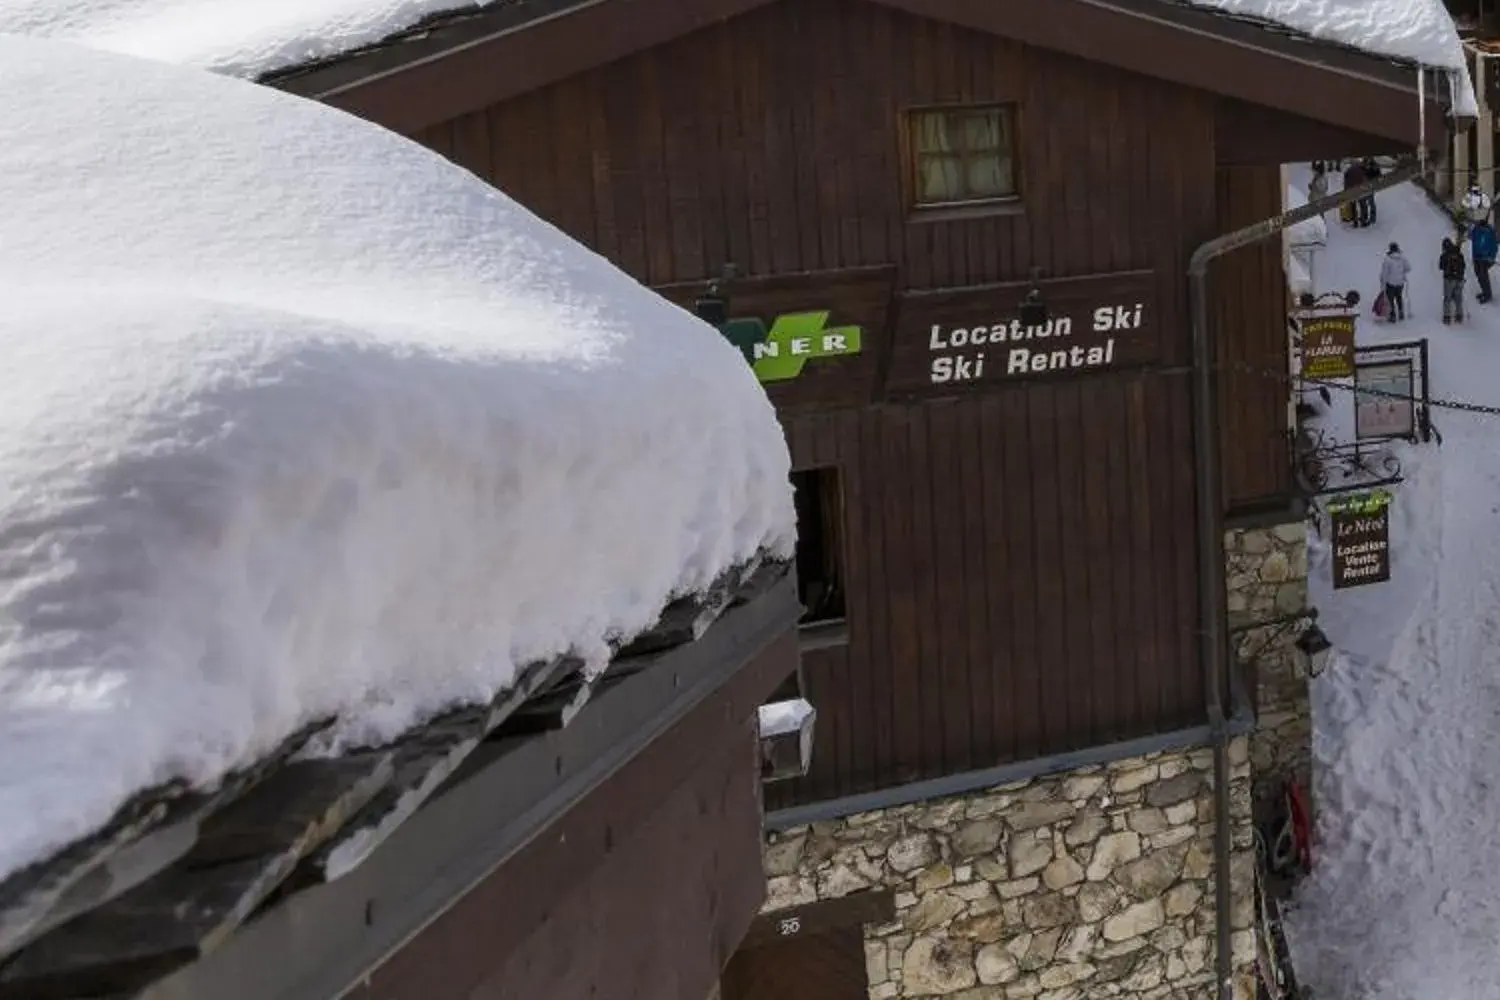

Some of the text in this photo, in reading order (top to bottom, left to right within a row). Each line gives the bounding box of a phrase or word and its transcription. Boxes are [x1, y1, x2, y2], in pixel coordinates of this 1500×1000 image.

[1093, 302, 1143, 331] Ski
[931, 339, 1114, 384] Ski Rental
